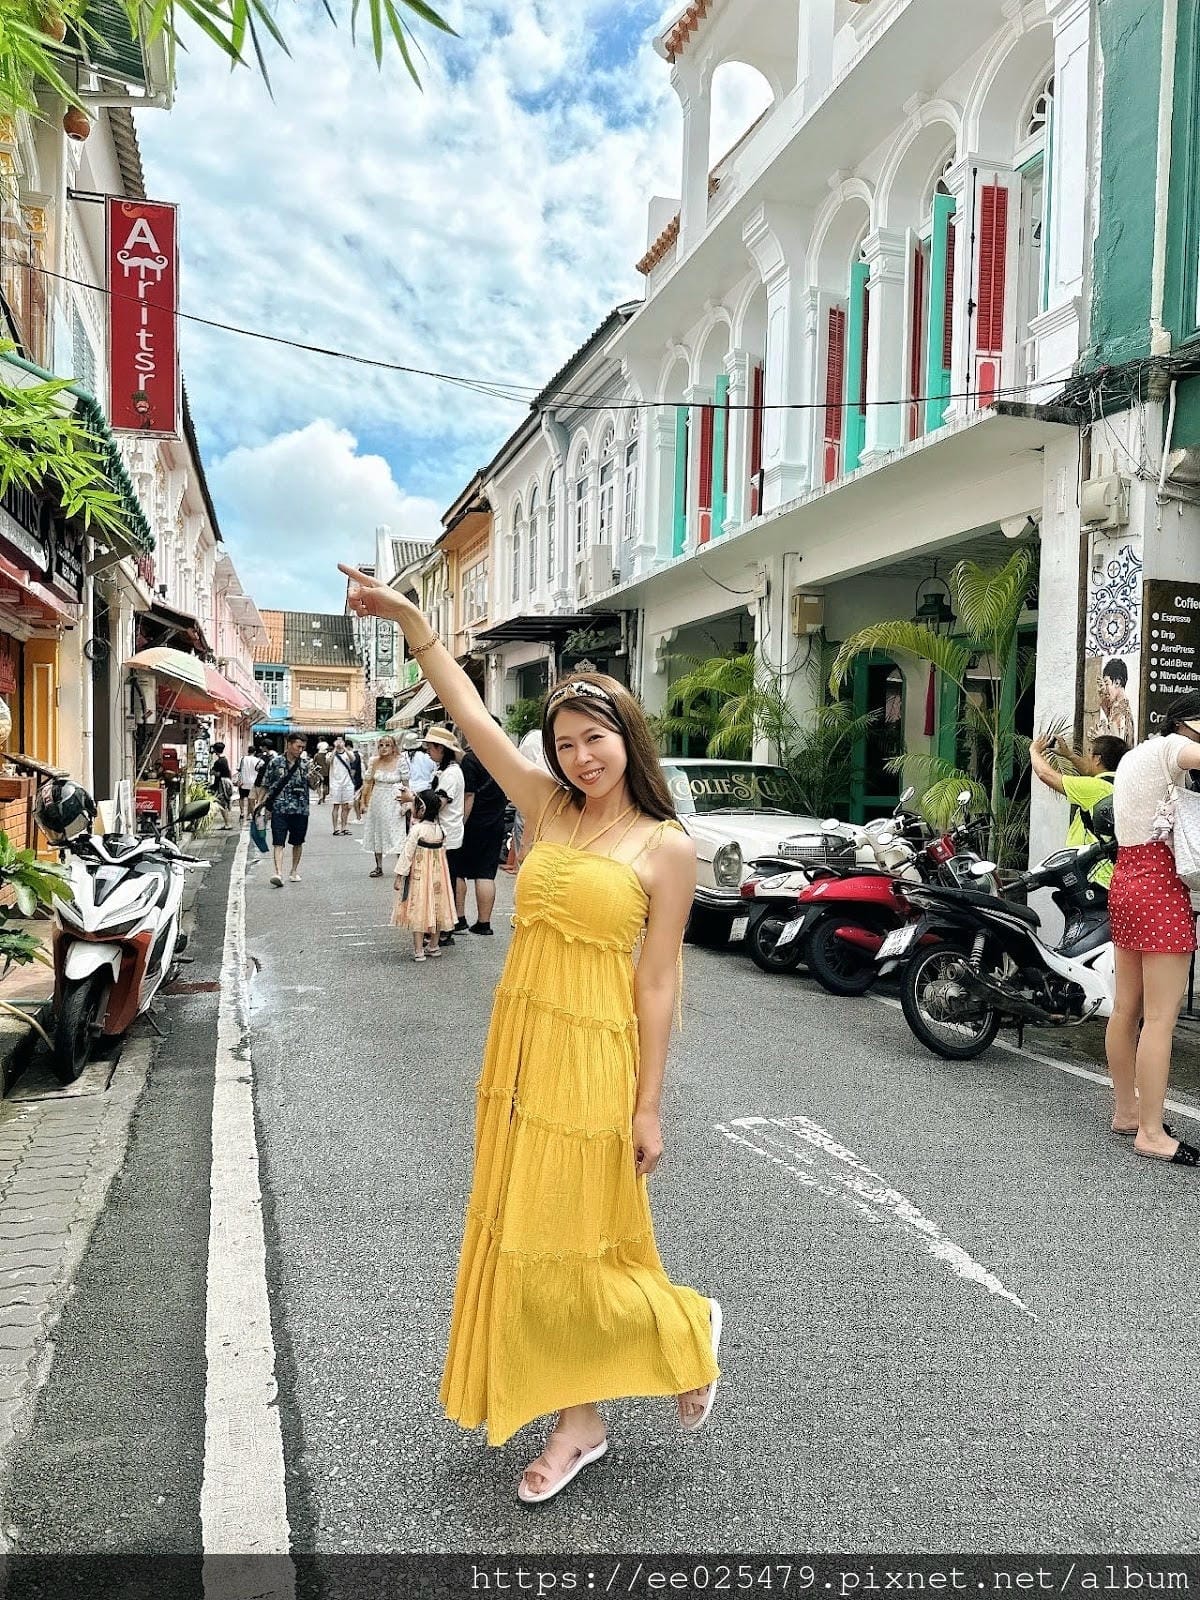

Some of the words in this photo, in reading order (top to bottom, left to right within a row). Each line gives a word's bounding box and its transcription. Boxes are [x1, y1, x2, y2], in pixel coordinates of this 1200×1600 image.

[1174, 596, 1200, 609] Coffe
[1161, 612, 1191, 623] Espresso
[1160, 630, 1176, 641] Drip
[1161, 644, 1196, 654] AeroPress
[1160, 658, 1175, 667] Cold
[1175, 659, 1193, 668] Brew
[1159, 671, 1176, 680] Nitro
[1176, 672, 1191, 681] Cold
[1159, 683, 1174, 693] Thai
